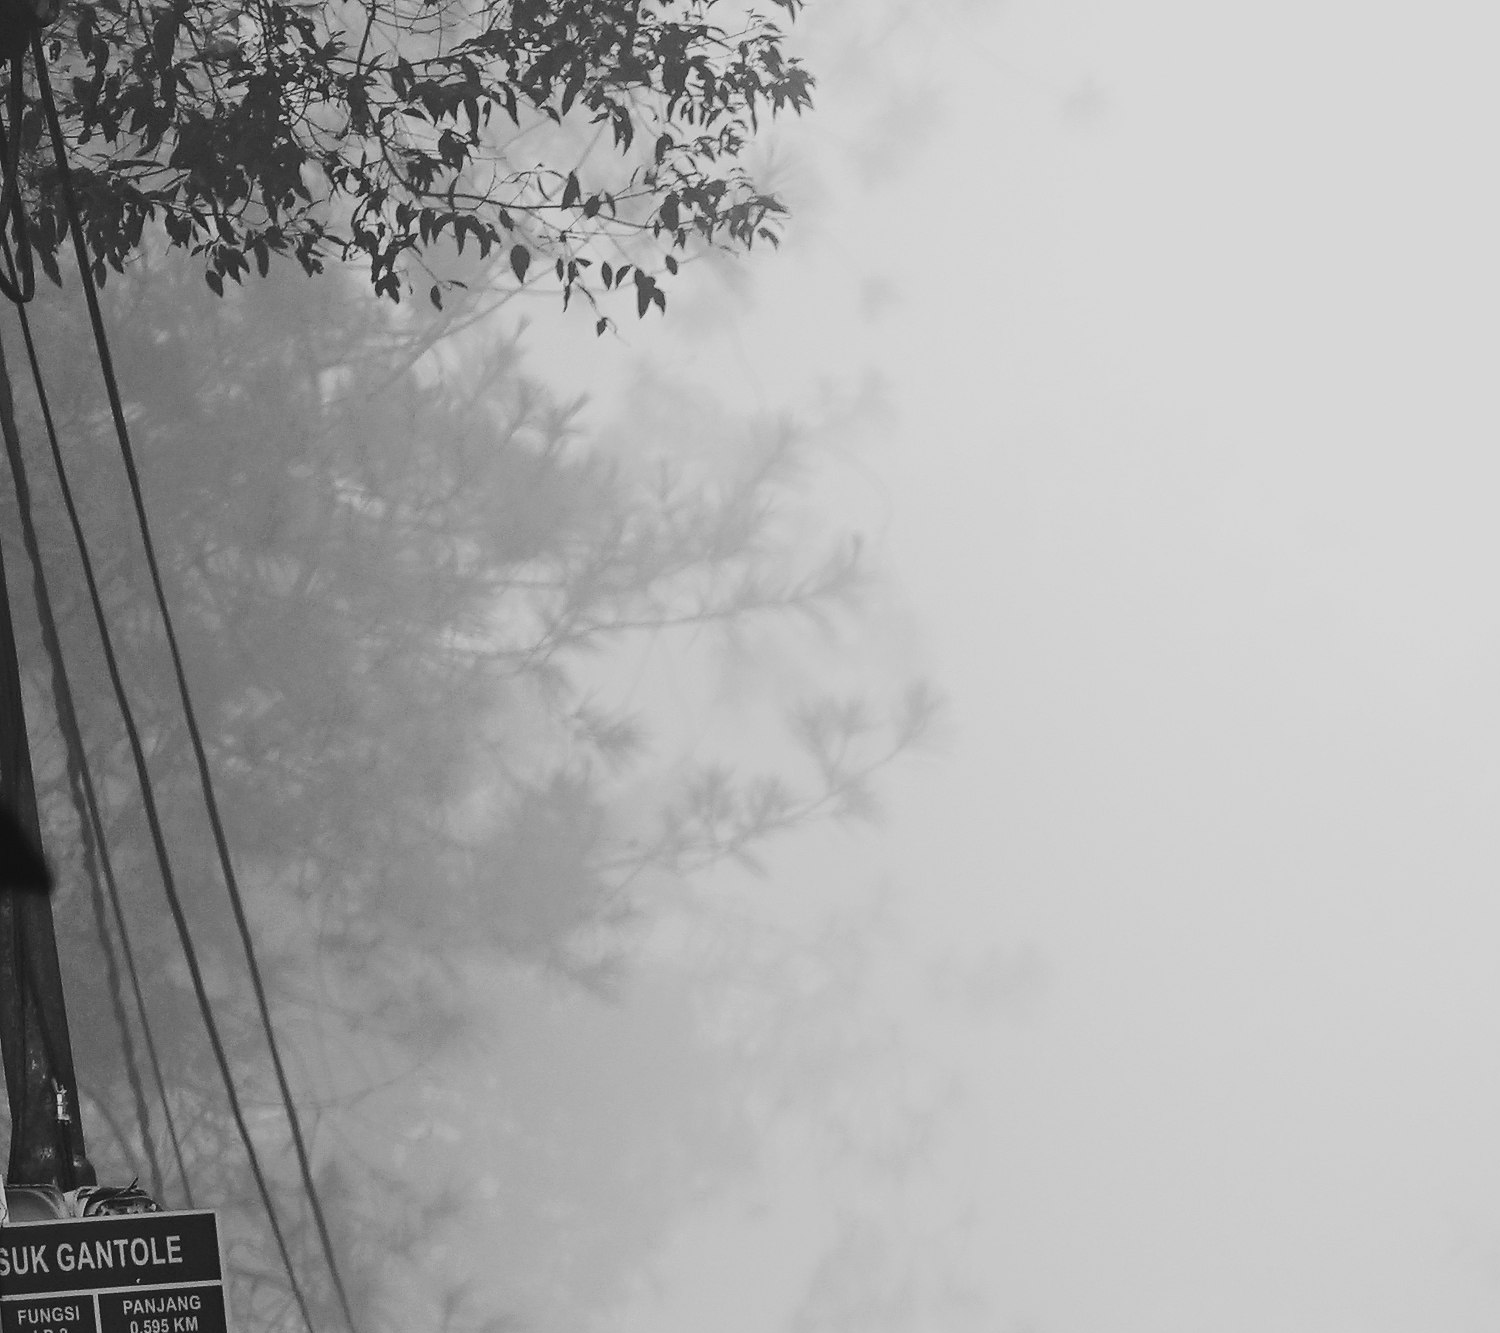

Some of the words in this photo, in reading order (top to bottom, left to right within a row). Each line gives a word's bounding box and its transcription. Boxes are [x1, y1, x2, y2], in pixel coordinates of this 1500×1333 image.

[56, 1235, 183, 1272] GANTOLE
[123, 1295, 201, 1315] PANJANG
[17, 1306, 80, 1326] FUNGSI
[174, 1316, 198, 1333] KM
